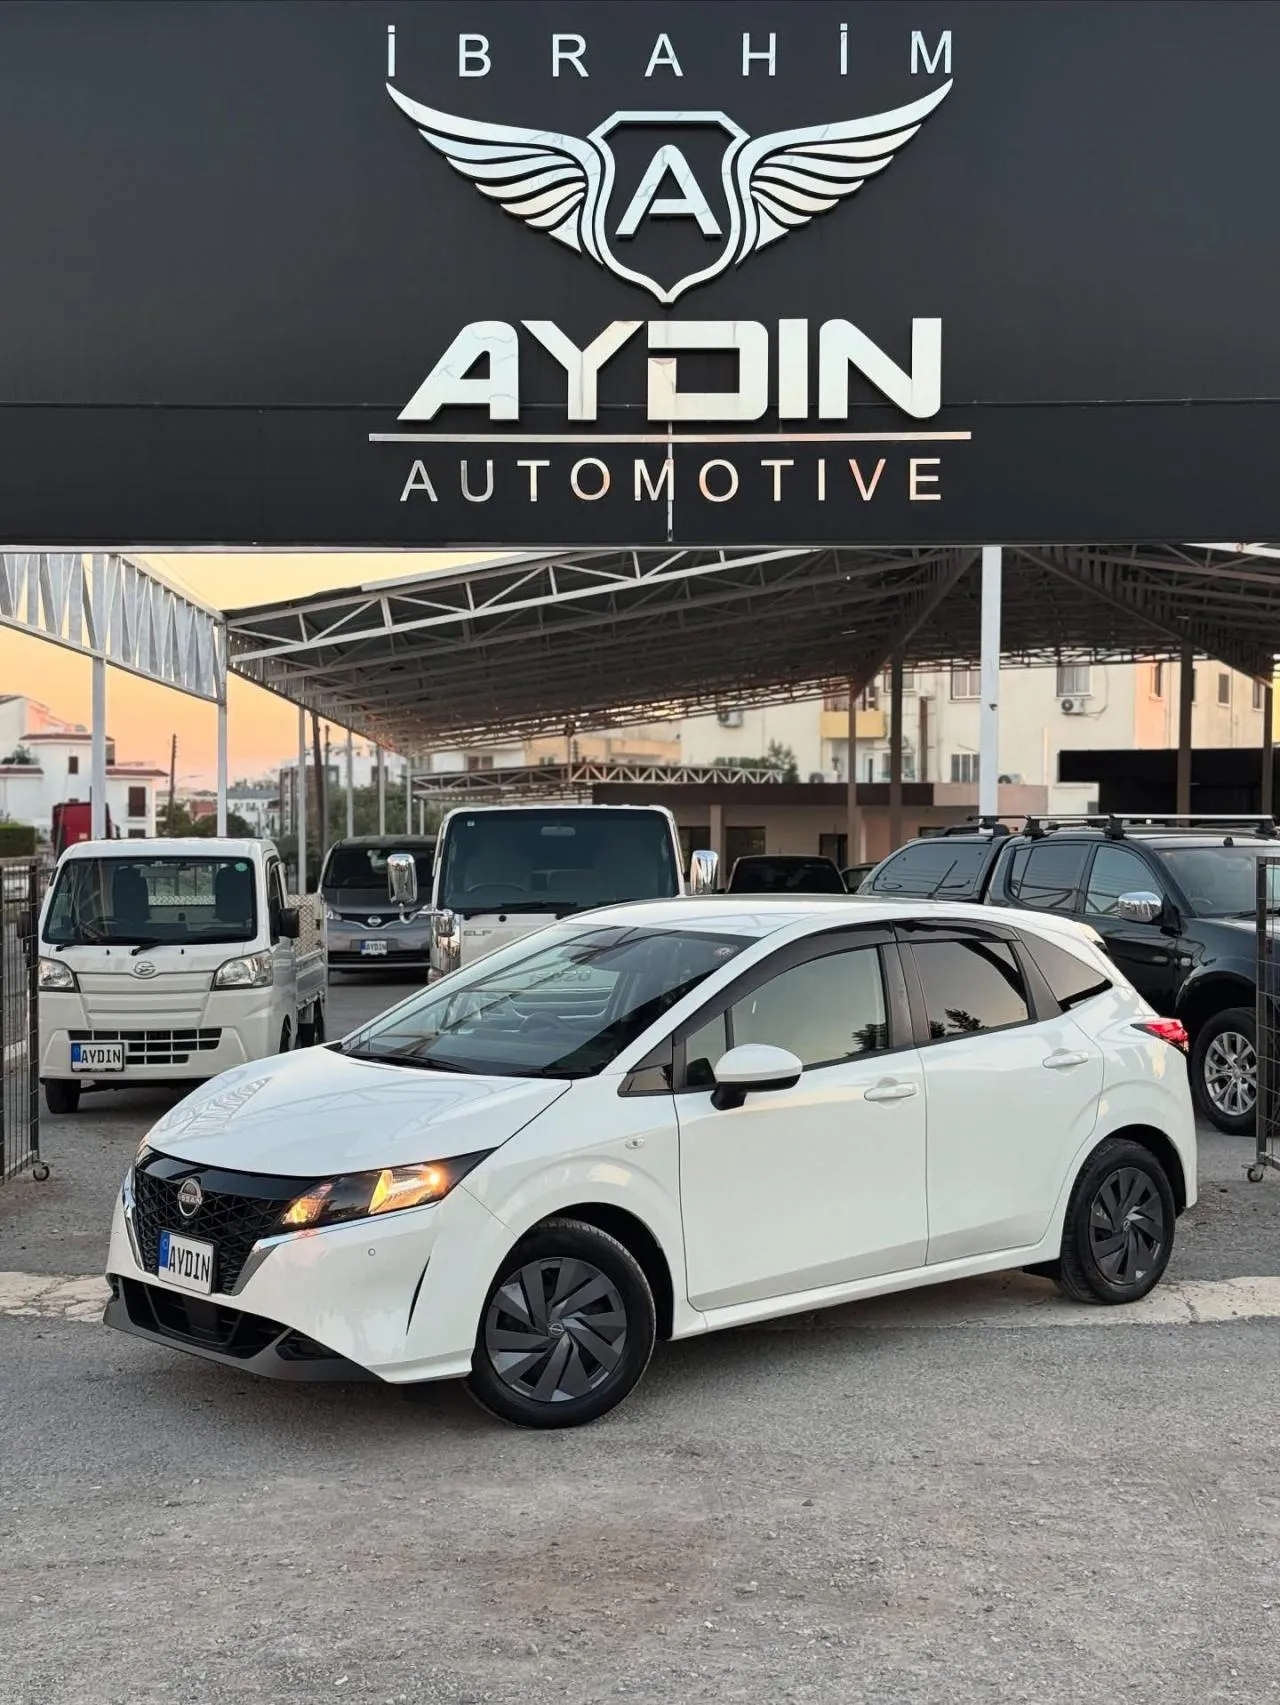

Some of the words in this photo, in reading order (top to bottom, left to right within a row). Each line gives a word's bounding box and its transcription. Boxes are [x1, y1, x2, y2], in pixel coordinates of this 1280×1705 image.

[387, 23, 953, 78] İBRAHİM
[615, 144, 722, 239] A
[396, 317, 942, 421] AYDIN
[400, 457, 942, 503] AUTOMOTIVE
[81, 1049, 121, 1063] AYDIN
[168, 1245, 211, 1283] AYDIN
